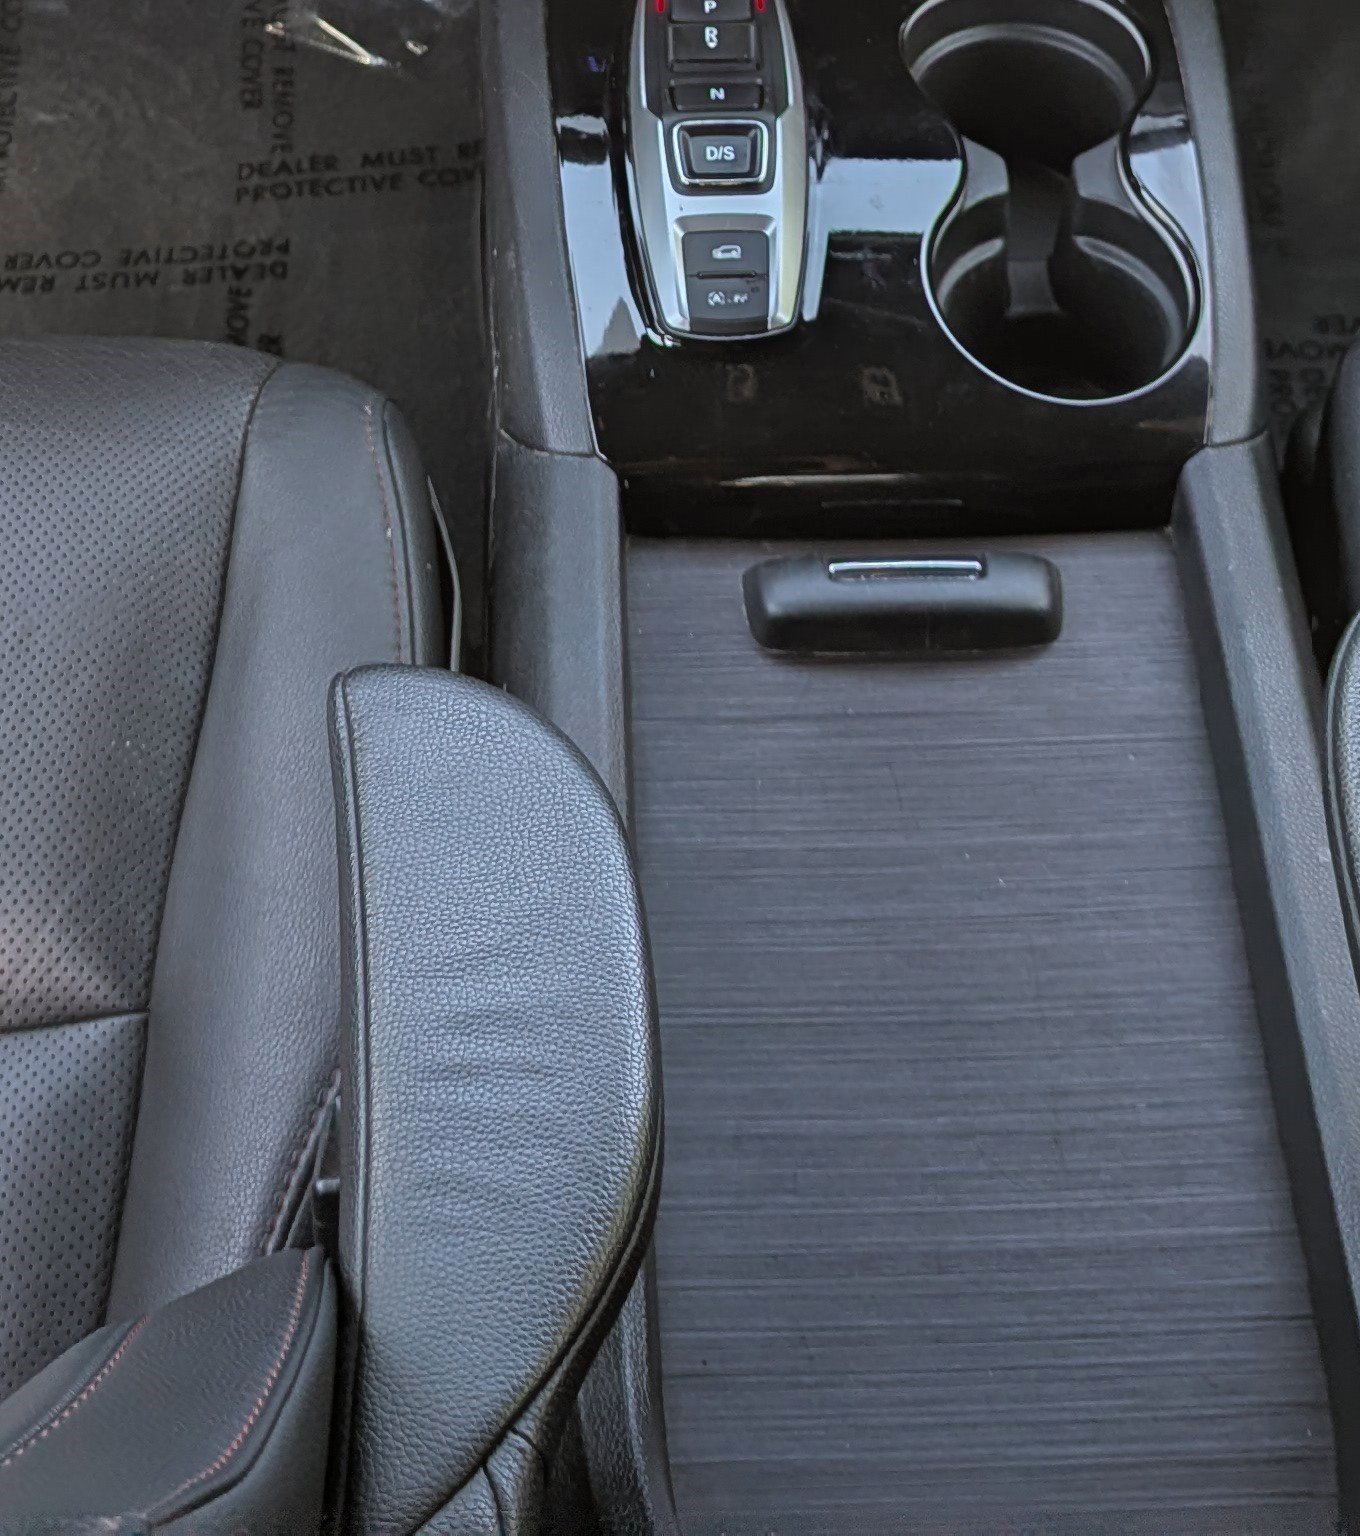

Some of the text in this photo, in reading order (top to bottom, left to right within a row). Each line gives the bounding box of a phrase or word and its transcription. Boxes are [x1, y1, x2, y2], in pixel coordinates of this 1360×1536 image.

[704, 0, 717, 14] P
[710, 88, 725, 101] N
[237, 153, 340, 182] DEALER
[360, 146, 441, 171] MUST
[706, 146, 735, 161] D/S
[235, 164, 484, 204] PROTECTIVE COV
[4, 238, 291, 273] PROTECTIVE COVER
[74, 269, 161, 294] MUST
[180, 258, 288, 286] DEALER
